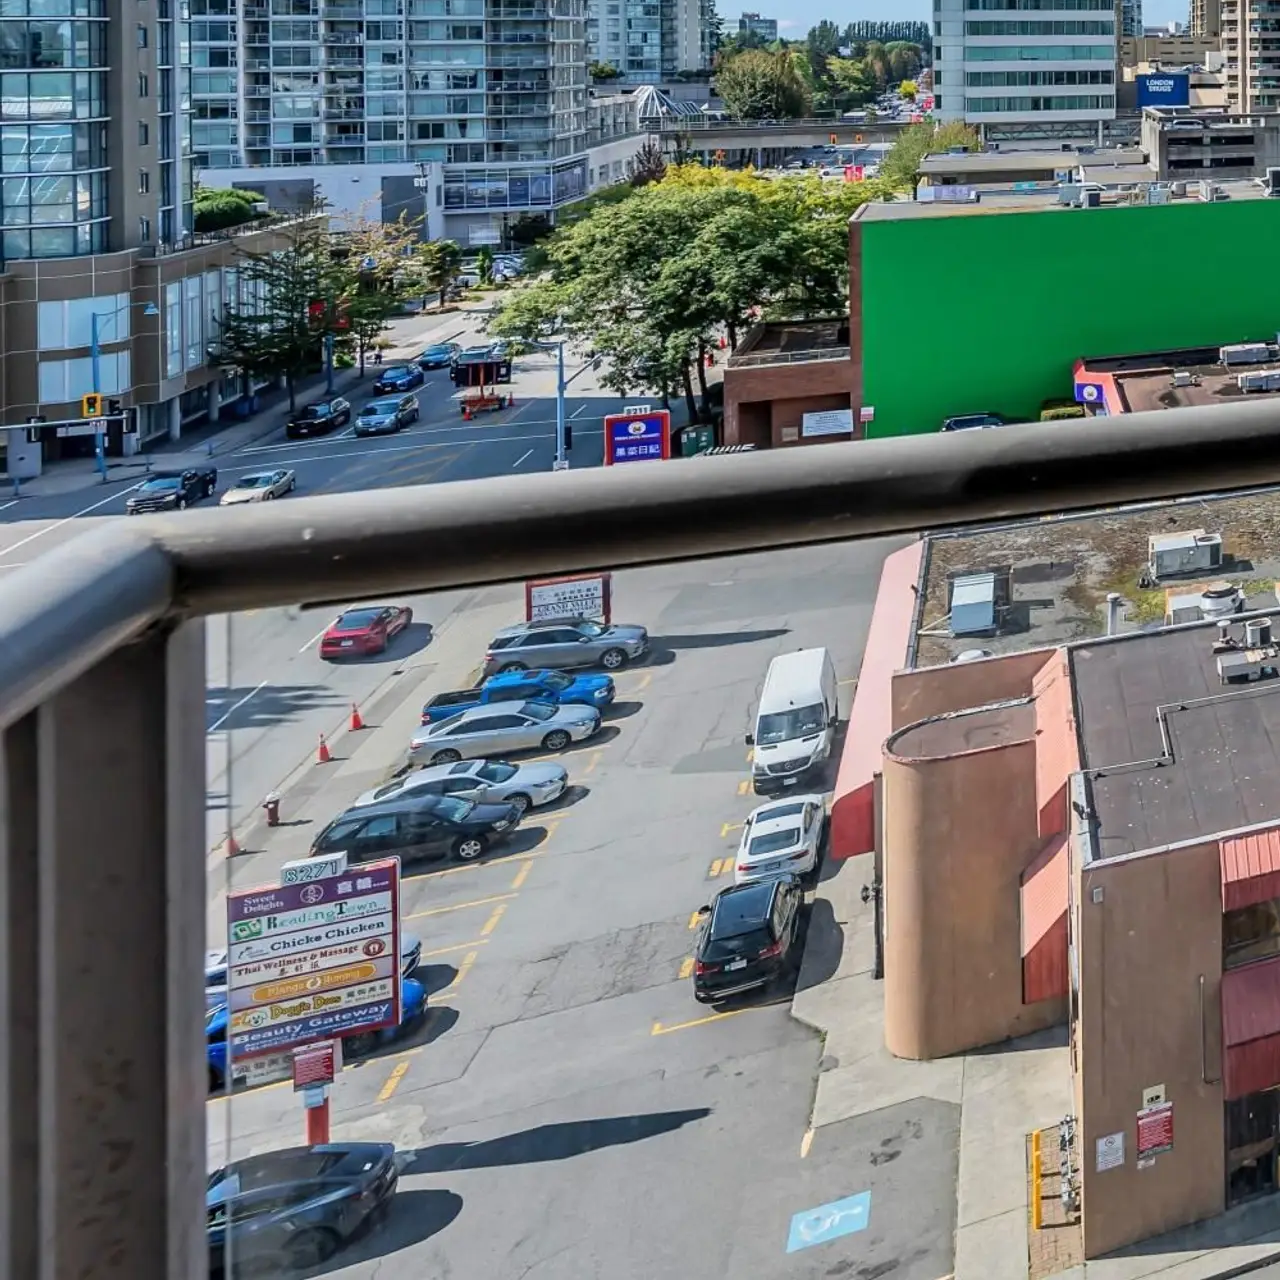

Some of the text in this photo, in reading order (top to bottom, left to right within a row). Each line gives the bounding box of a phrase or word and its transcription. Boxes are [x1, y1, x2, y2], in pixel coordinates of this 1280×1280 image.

[1146, 79, 1174, 87] LONDON
[284, 860, 338, 883] 8271
[242, 900, 285, 914] Delights
[243, 894, 276, 907] Sweet
[325, 920, 385, 939] Chicken
[235, 965, 261, 977] Thai
[264, 955, 308, 970] Wellness
[320, 945, 359, 958] Massage
[233, 1023, 303, 1046] Beauty
[309, 1003, 390, 1028] Gateway
